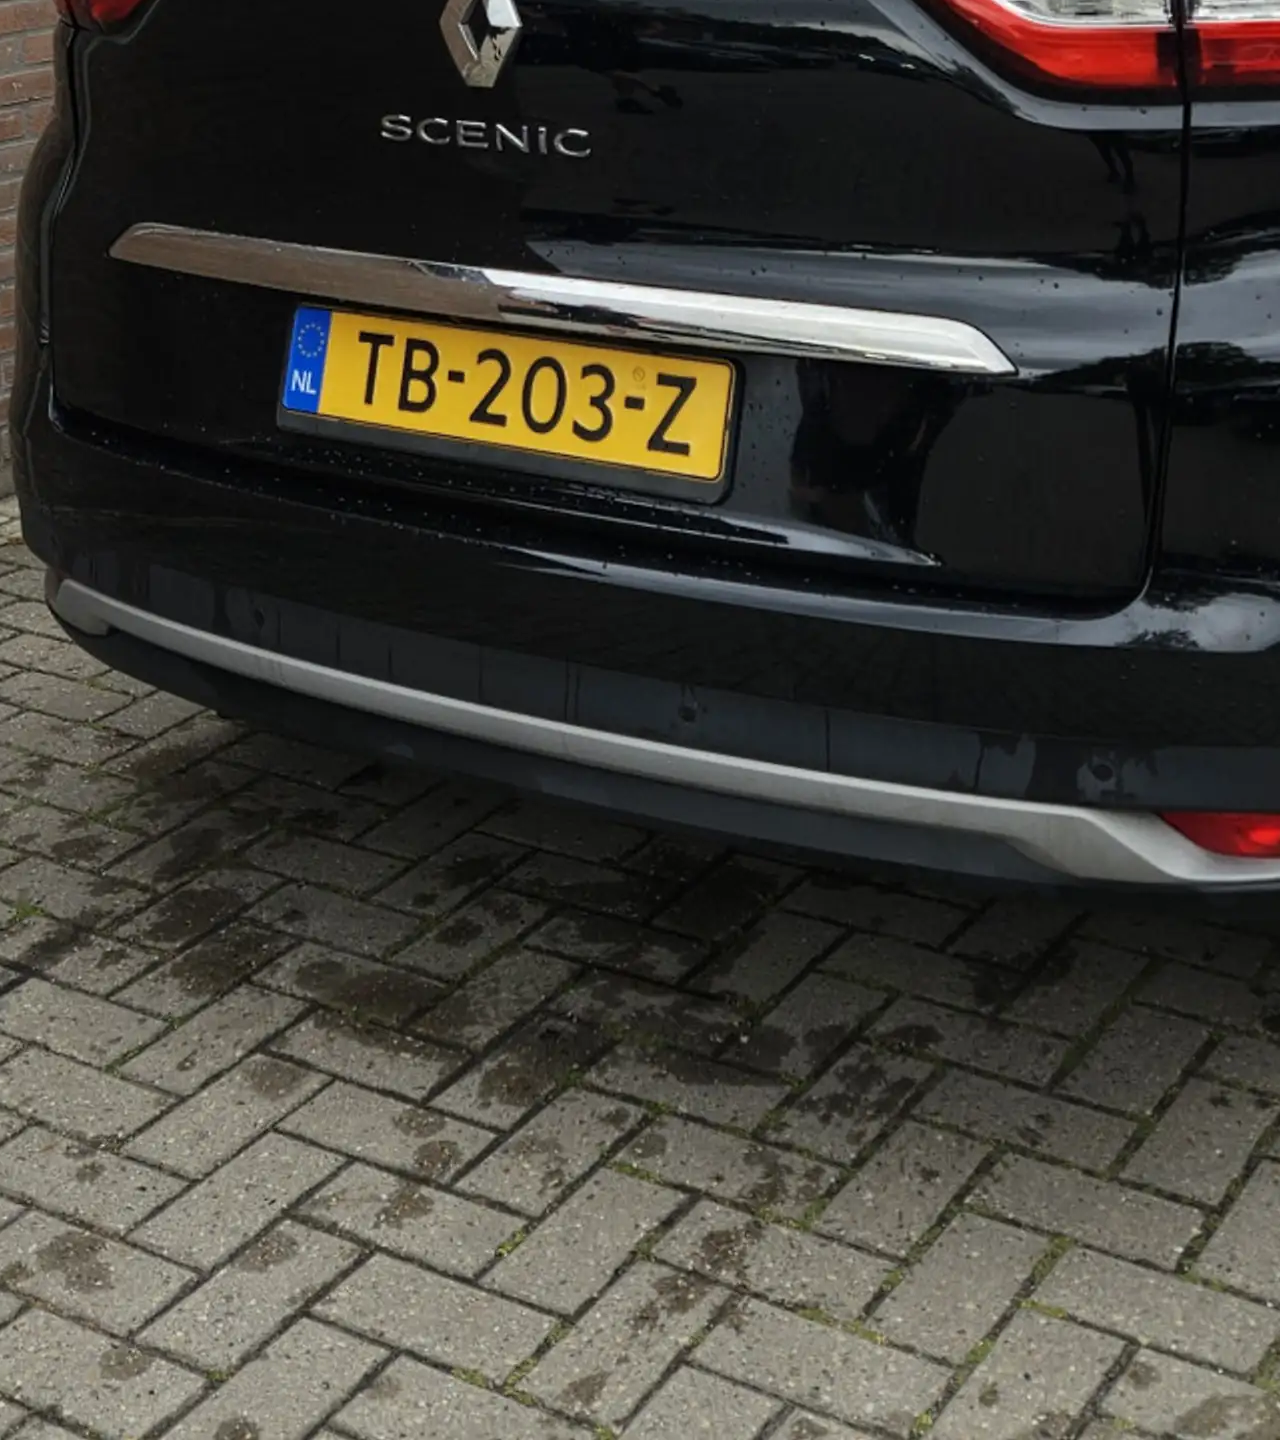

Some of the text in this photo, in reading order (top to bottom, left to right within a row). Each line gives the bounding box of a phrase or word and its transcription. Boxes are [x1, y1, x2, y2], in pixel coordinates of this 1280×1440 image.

[380, 114, 591, 158] SCENIC
[291, 368, 317, 395] NL
[358, 331, 697, 456] TB-203-Z
